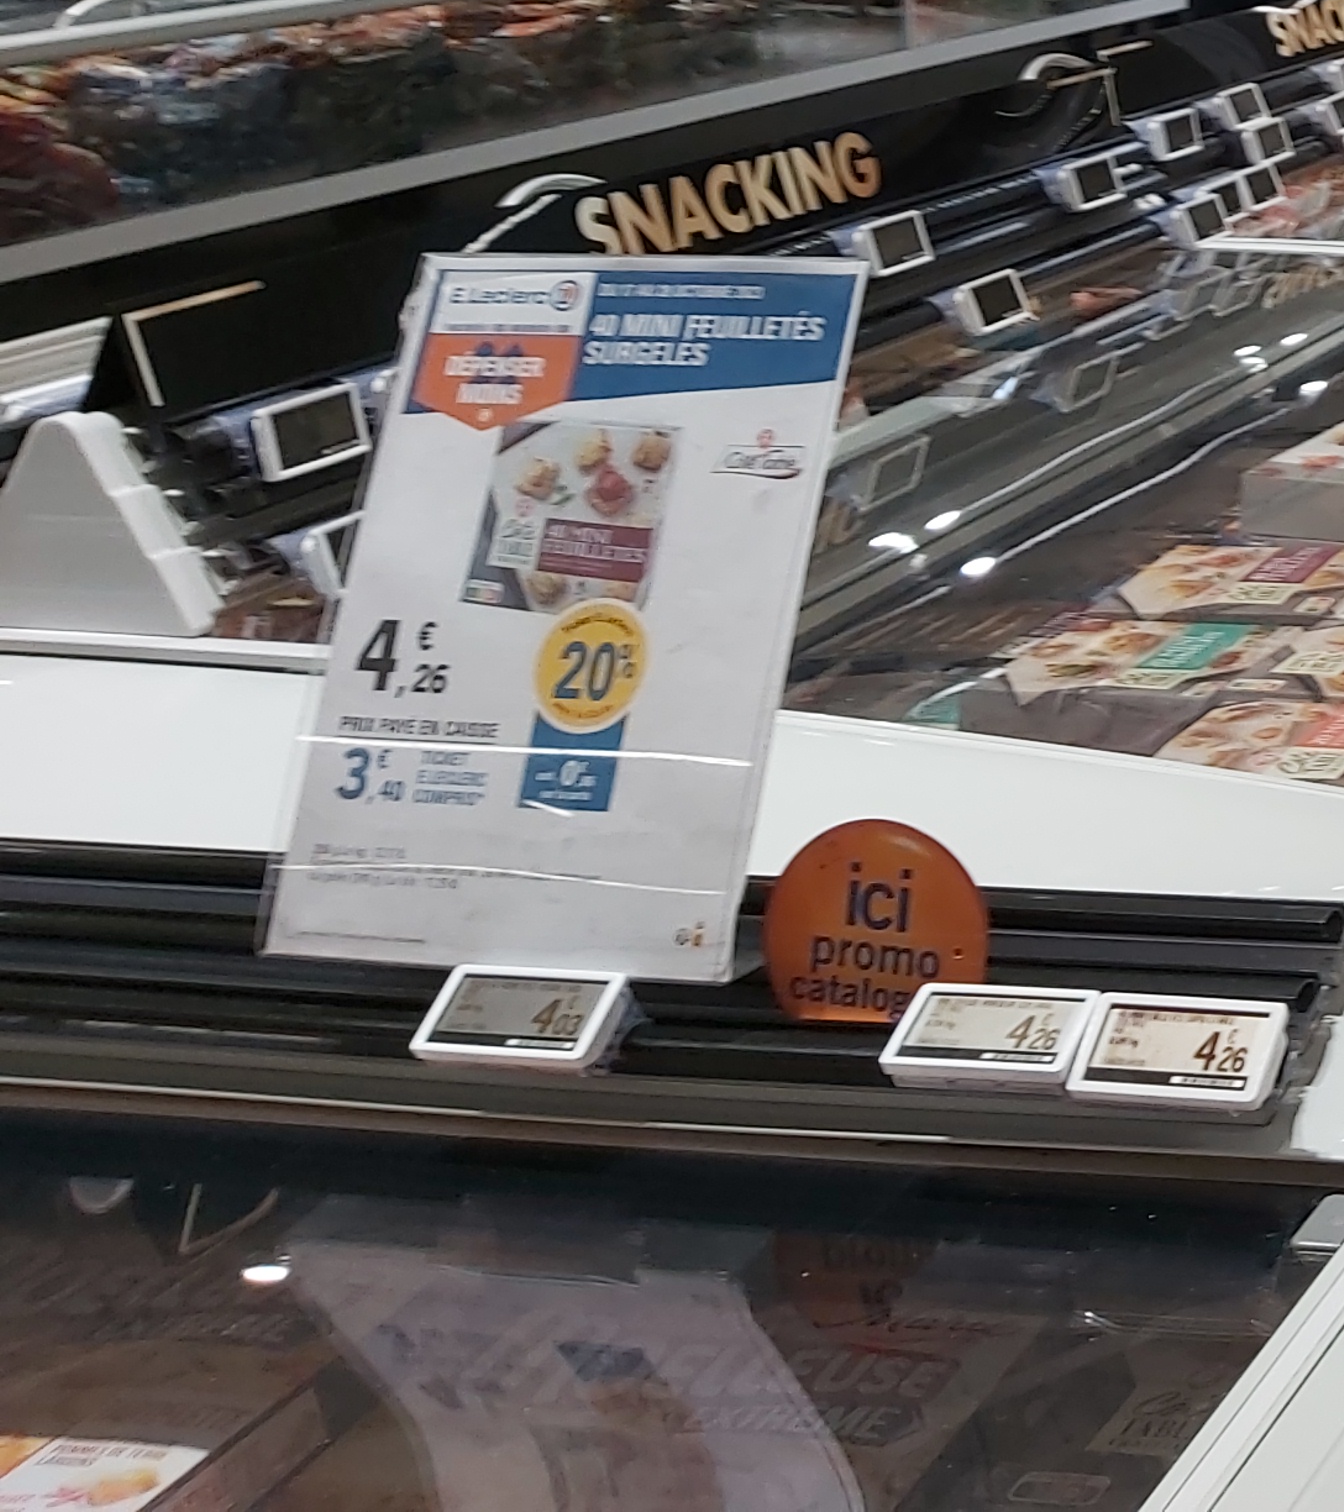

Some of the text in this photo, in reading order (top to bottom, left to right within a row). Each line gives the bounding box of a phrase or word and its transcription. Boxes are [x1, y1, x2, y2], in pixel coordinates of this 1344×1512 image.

[574, 132, 882, 255] SNACKING
[619, 314, 684, 337] MINI
[682, 310, 827, 340] FEUILLETÉS
[355, 620, 401, 691] 4
[334, 748, 369, 799] 3
[845, 861, 915, 933] ici
[810, 935, 940, 979] promo
[530, 998, 563, 1034] 4
[789, 974, 912, 1019] catalog
[1006, 1015, 1061, 1050] 4 26
[1193, 1031, 1248, 1073] 4 26
